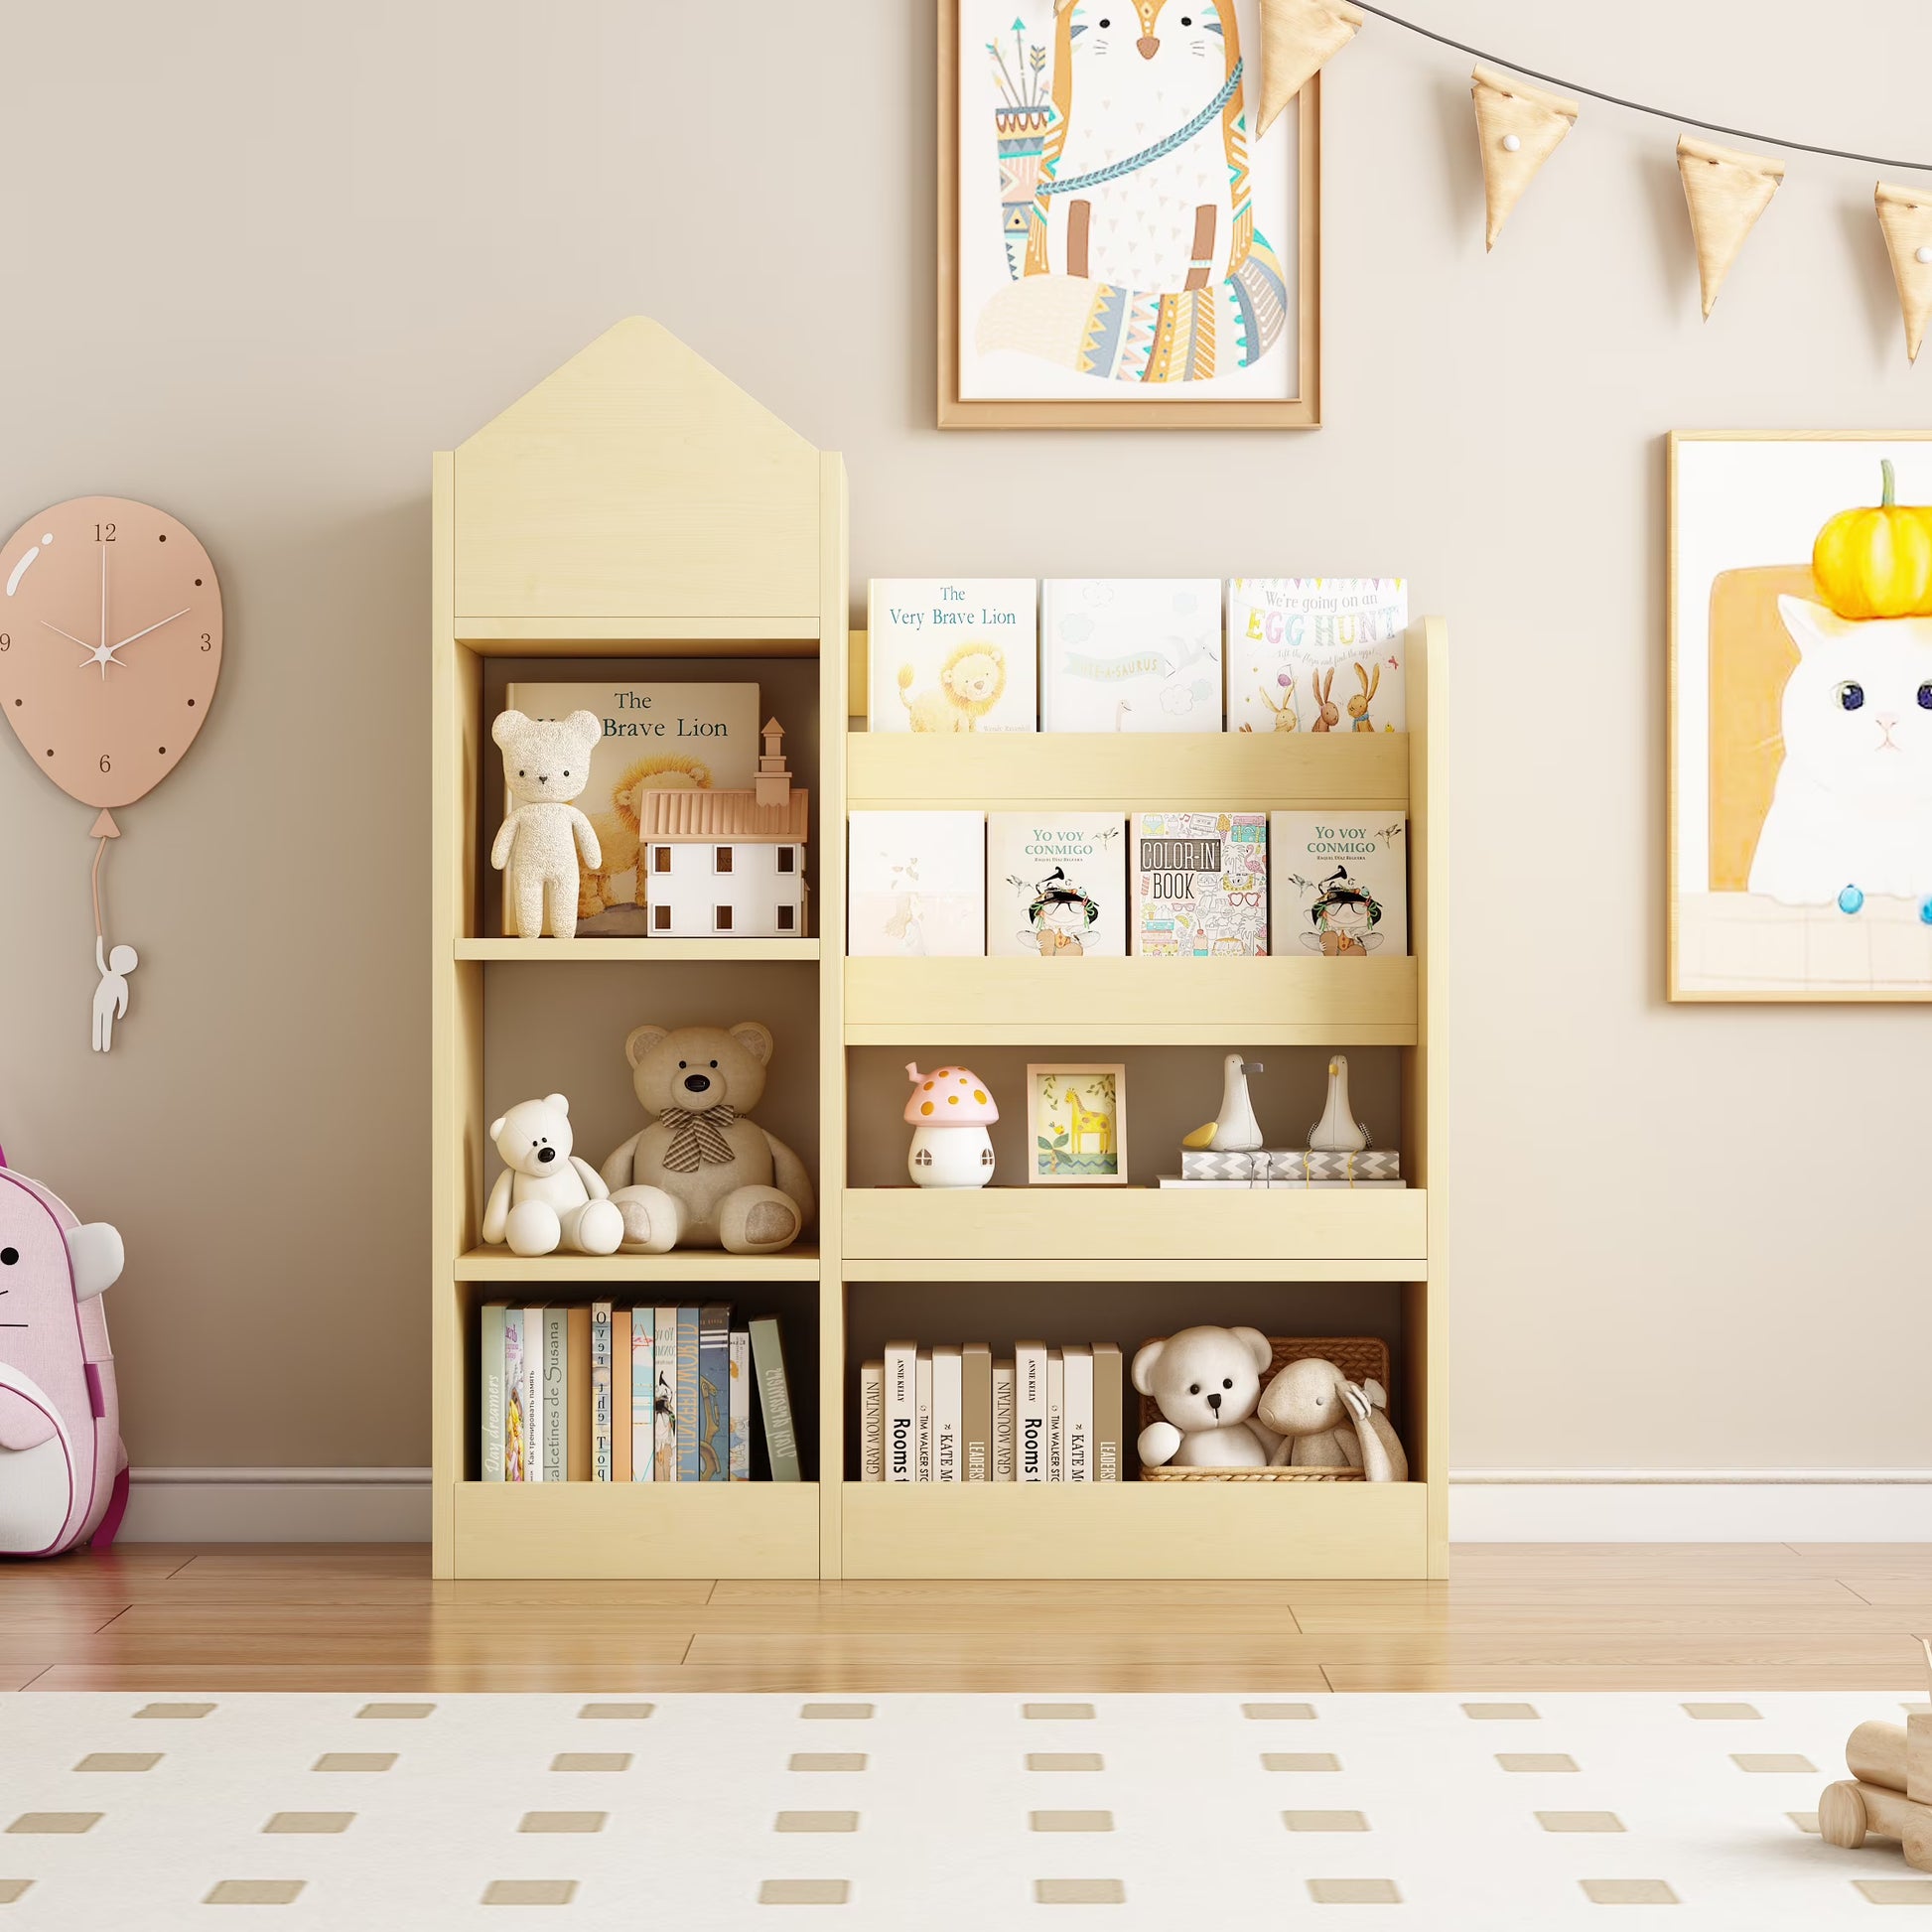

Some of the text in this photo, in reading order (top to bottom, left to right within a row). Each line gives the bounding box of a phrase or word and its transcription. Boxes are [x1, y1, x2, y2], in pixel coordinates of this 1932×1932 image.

[94, 523, 117, 542] 12
[939, 585, 966, 601] The
[1265, 591, 1379, 614] We're going on an
[890, 609, 1017, 631] Very Brave Lion
[1245, 605, 1400, 647] EGG HUNT
[0, 632, 12, 652] 9
[200, 632, 212, 652] 3
[614, 691, 653, 709] The
[603, 718, 729, 738] Brave Lion
[98, 755, 112, 773] 6
[1153, 873, 1194, 898] BOOK
[544, 1321, 563, 1383] Susana
[544, 1387, 560, 1407] de
[483, 1374, 502, 1473] Day dreamers
[866, 1381, 881, 1475] GRAY MOUNTAIN
[919, 1415, 929, 1431] TIM
[997, 1381, 1012, 1475] GRAY MOUNTAIN
[1050, 1415, 1060, 1431] TIM
[893, 1419, 911, 1474] Rooms
[919, 1432, 929, 1467] WALKER
[940, 1434, 953, 1481] KATE M
[1024, 1419, 1042, 1474] Rooms
[1050, 1432, 1060, 1467] WALKER
[1072, 1434, 1085, 1481] KATE M
